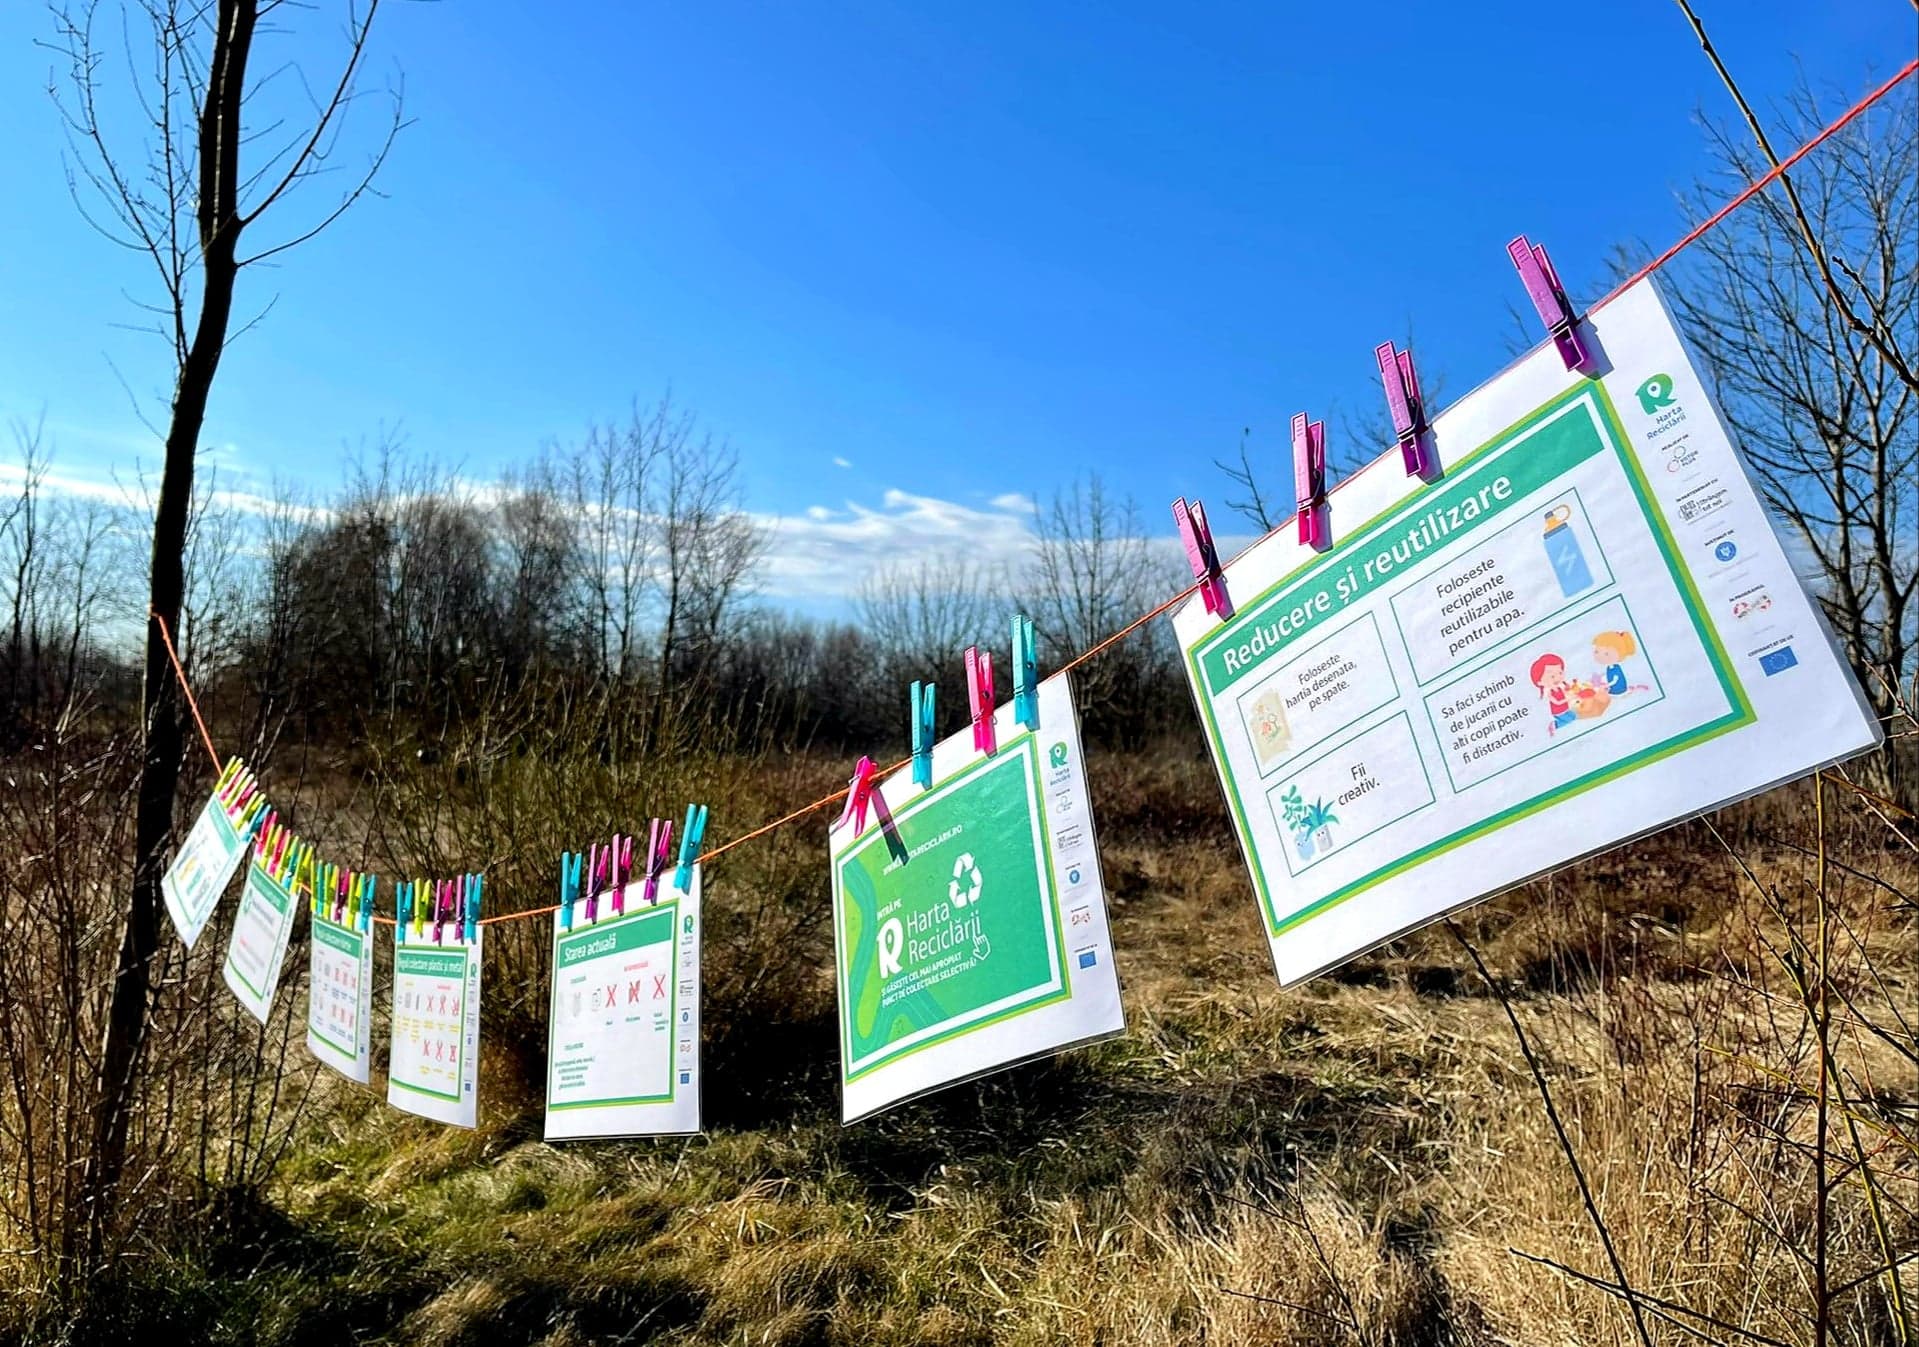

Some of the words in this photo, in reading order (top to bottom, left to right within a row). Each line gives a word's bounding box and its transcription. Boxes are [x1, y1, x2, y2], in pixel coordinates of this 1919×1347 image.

[1656, 407, 1682, 424] Harta
[1223, 590, 1332, 676] Reducere
[1336, 568, 1359, 605] și
[1363, 474, 1513, 583] reutilizare
[1436, 559, 1495, 599] Foloseste
[1440, 590, 1515, 638] reutilizabile
[1441, 574, 1504, 616] recipiente
[1448, 624, 1493, 657] pentru
[1495, 608, 1525, 627] apa.
[1285, 688, 1312, 709] hartia
[1312, 661, 1357, 692] desenata,
[1298, 654, 1341, 685] Foloseste
[1308, 696, 1321, 712] pe
[1322, 680, 1351, 702] spate.
[1441, 707, 1455, 719] Sa
[1455, 694, 1474, 712] faci
[1475, 675, 1515, 702] schimb
[1450, 721, 1464, 733] de
[1464, 701, 1497, 728] jucarii
[1498, 696, 1512, 709] cu
[1453, 735, 1469, 750] alti
[1470, 721, 1496, 741] copii
[1497, 707, 1528, 731] poate
[1463, 752, 1471, 764] fi
[1473, 730, 1524, 760] distractiv.
[1351, 762, 1366, 780] Fii
[1338, 777, 1380, 806] creativ.
[906, 902, 950, 938] Harta
[908, 910, 981, 965] Reciclării
[565, 944, 587, 962] Starea
[587, 933, 617, 956] actuală
